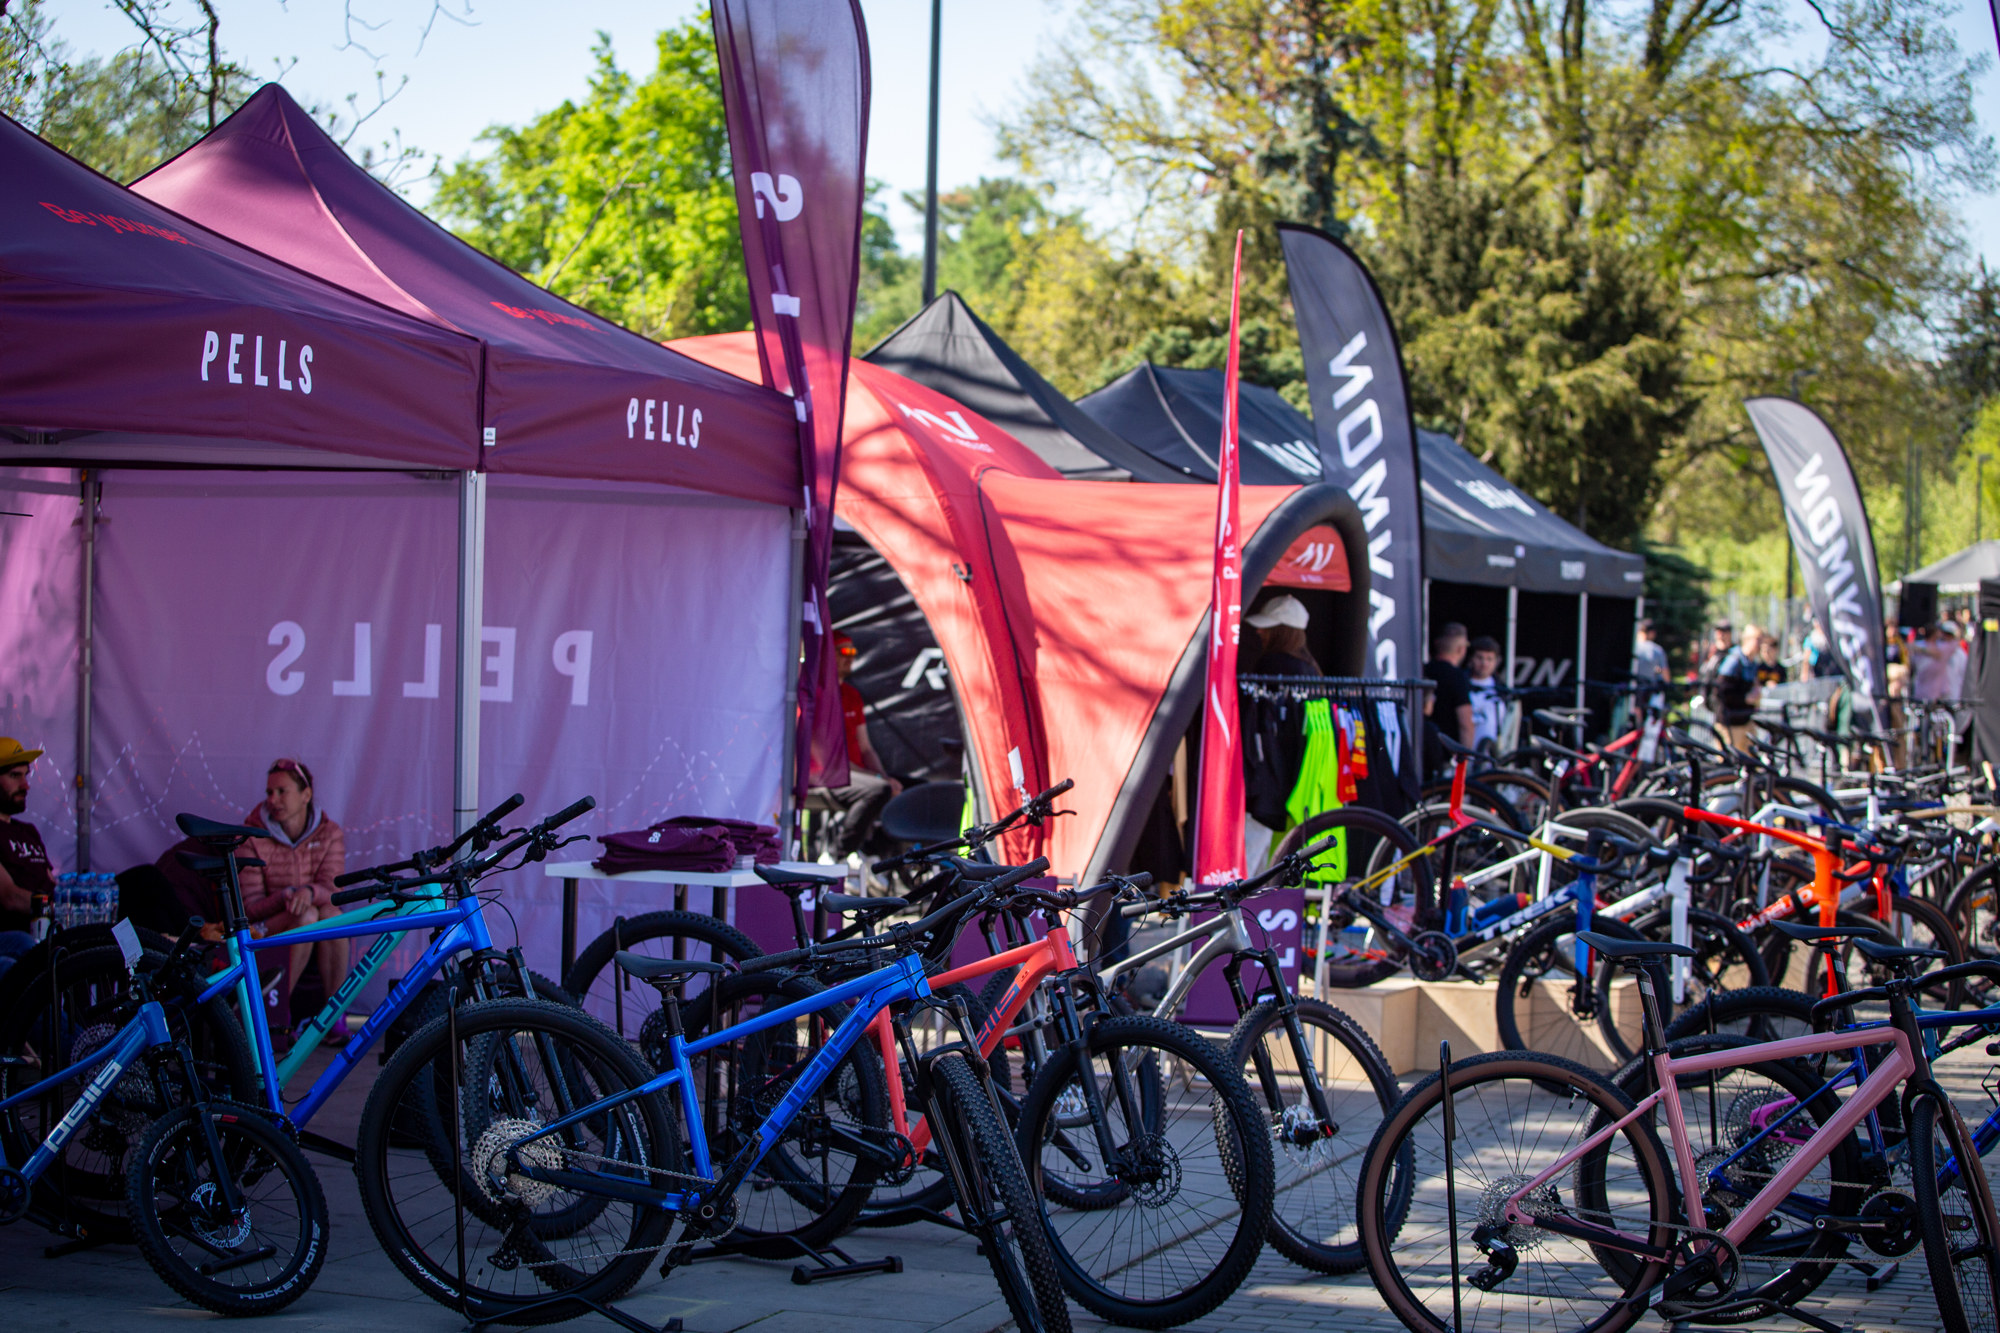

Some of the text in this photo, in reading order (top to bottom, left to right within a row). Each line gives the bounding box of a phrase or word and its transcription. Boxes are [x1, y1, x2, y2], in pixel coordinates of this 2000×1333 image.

[39, 201, 97, 226] Be
[201, 330, 314, 395] PELLS
[626, 397, 703, 450] PELLS
[240, 1240, 319, 1300] ROCKET RON
